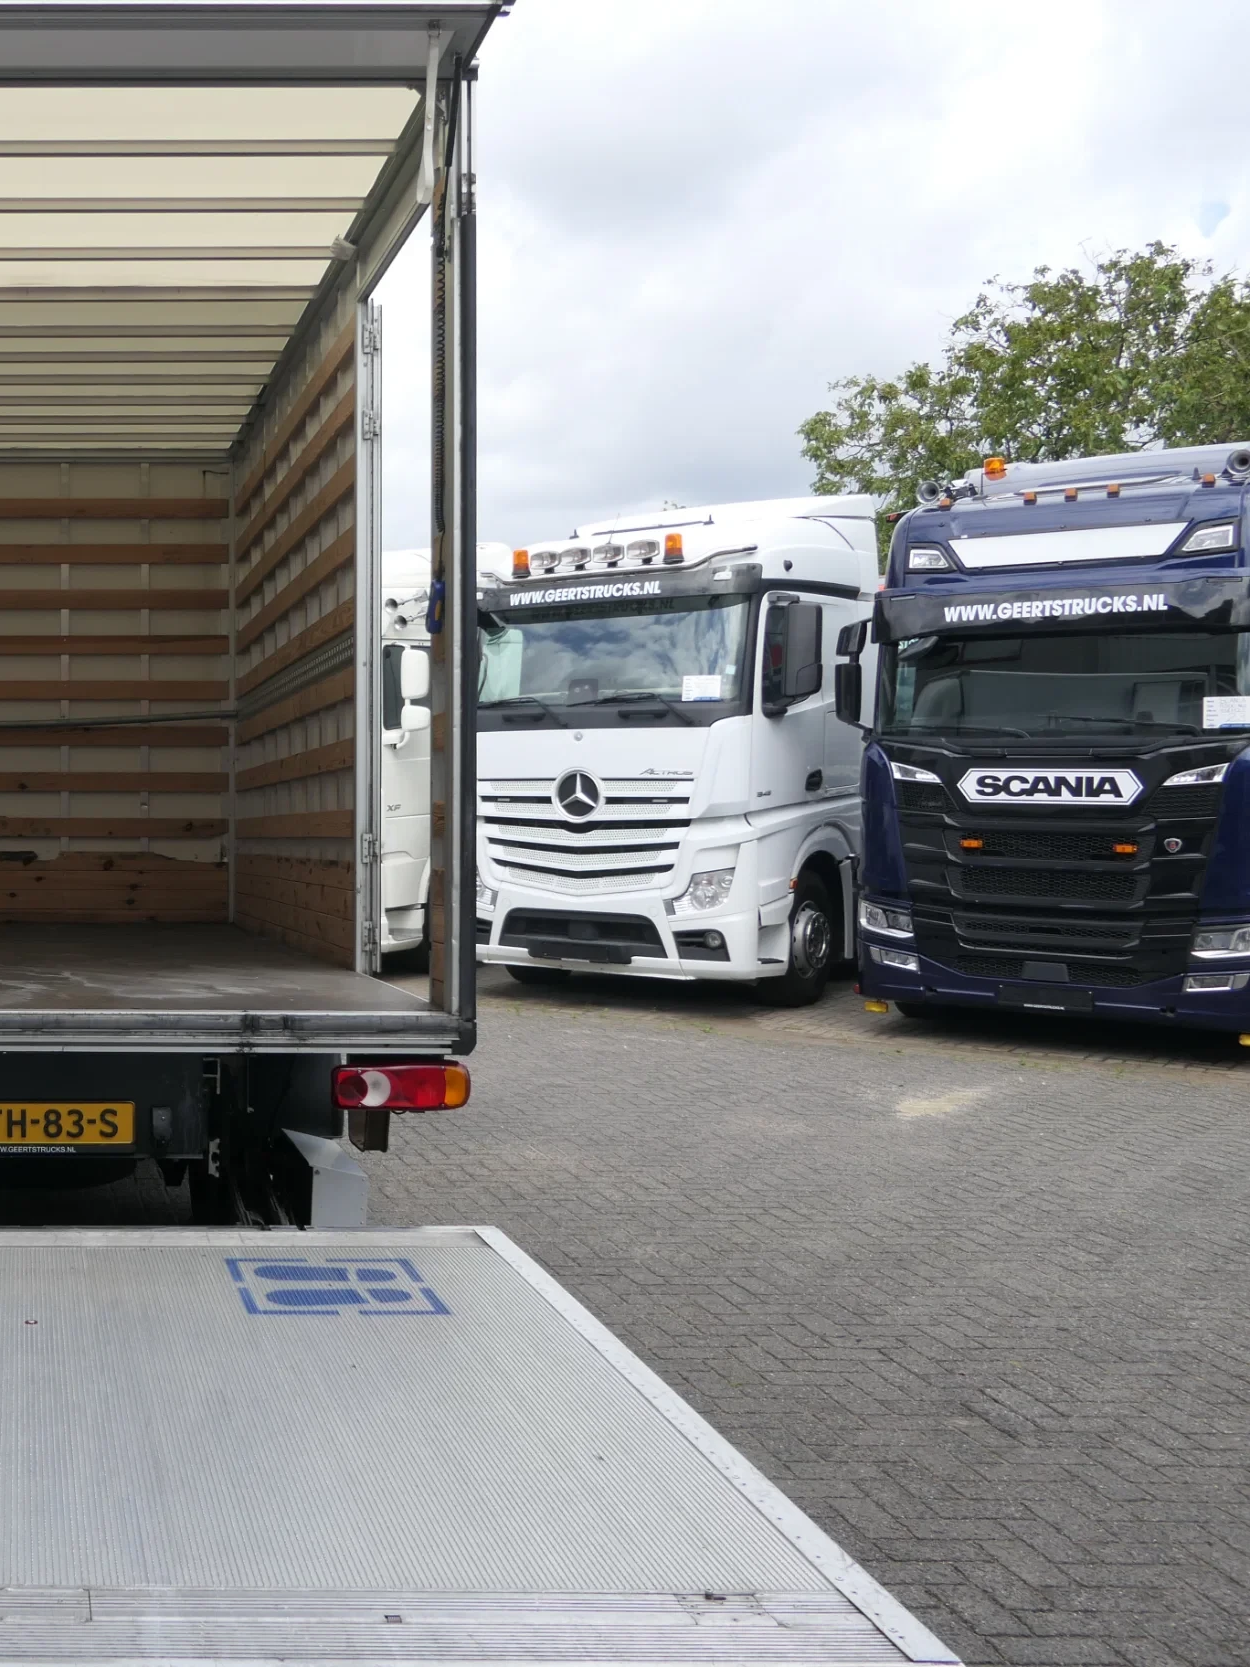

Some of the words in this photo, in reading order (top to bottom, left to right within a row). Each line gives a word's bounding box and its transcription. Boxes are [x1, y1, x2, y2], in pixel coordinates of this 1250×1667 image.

[509, 580, 662, 606] WWW.GEERTSTRUCKS.NL
[943, 593, 1169, 623] WWW.GEERTSTRUCKS.NL
[974, 774, 1124, 799] SCANIA
[386, 803, 402, 812] XF
